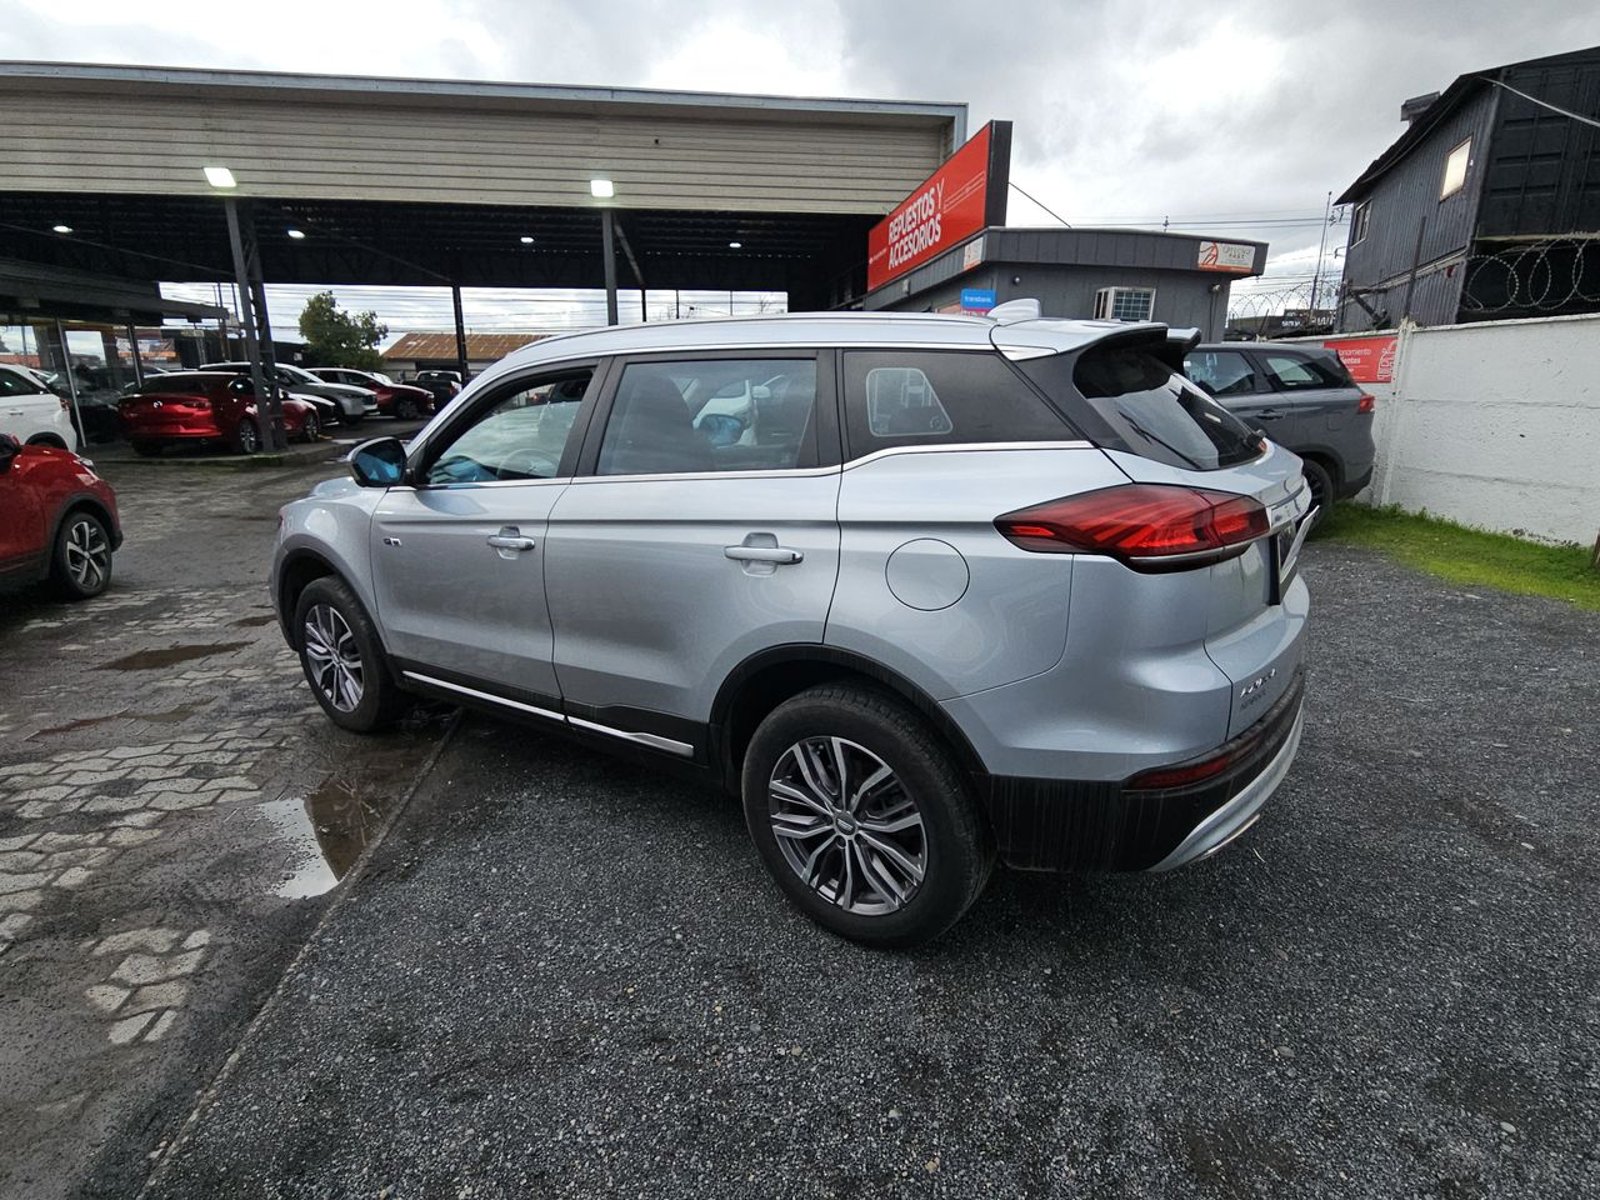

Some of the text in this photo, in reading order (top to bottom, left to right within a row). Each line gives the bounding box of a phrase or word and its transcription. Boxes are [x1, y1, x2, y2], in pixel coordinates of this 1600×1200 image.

[888, 177, 945, 245] REPUESTOS Y
[888, 213, 942, 270] ACCESORIOS
